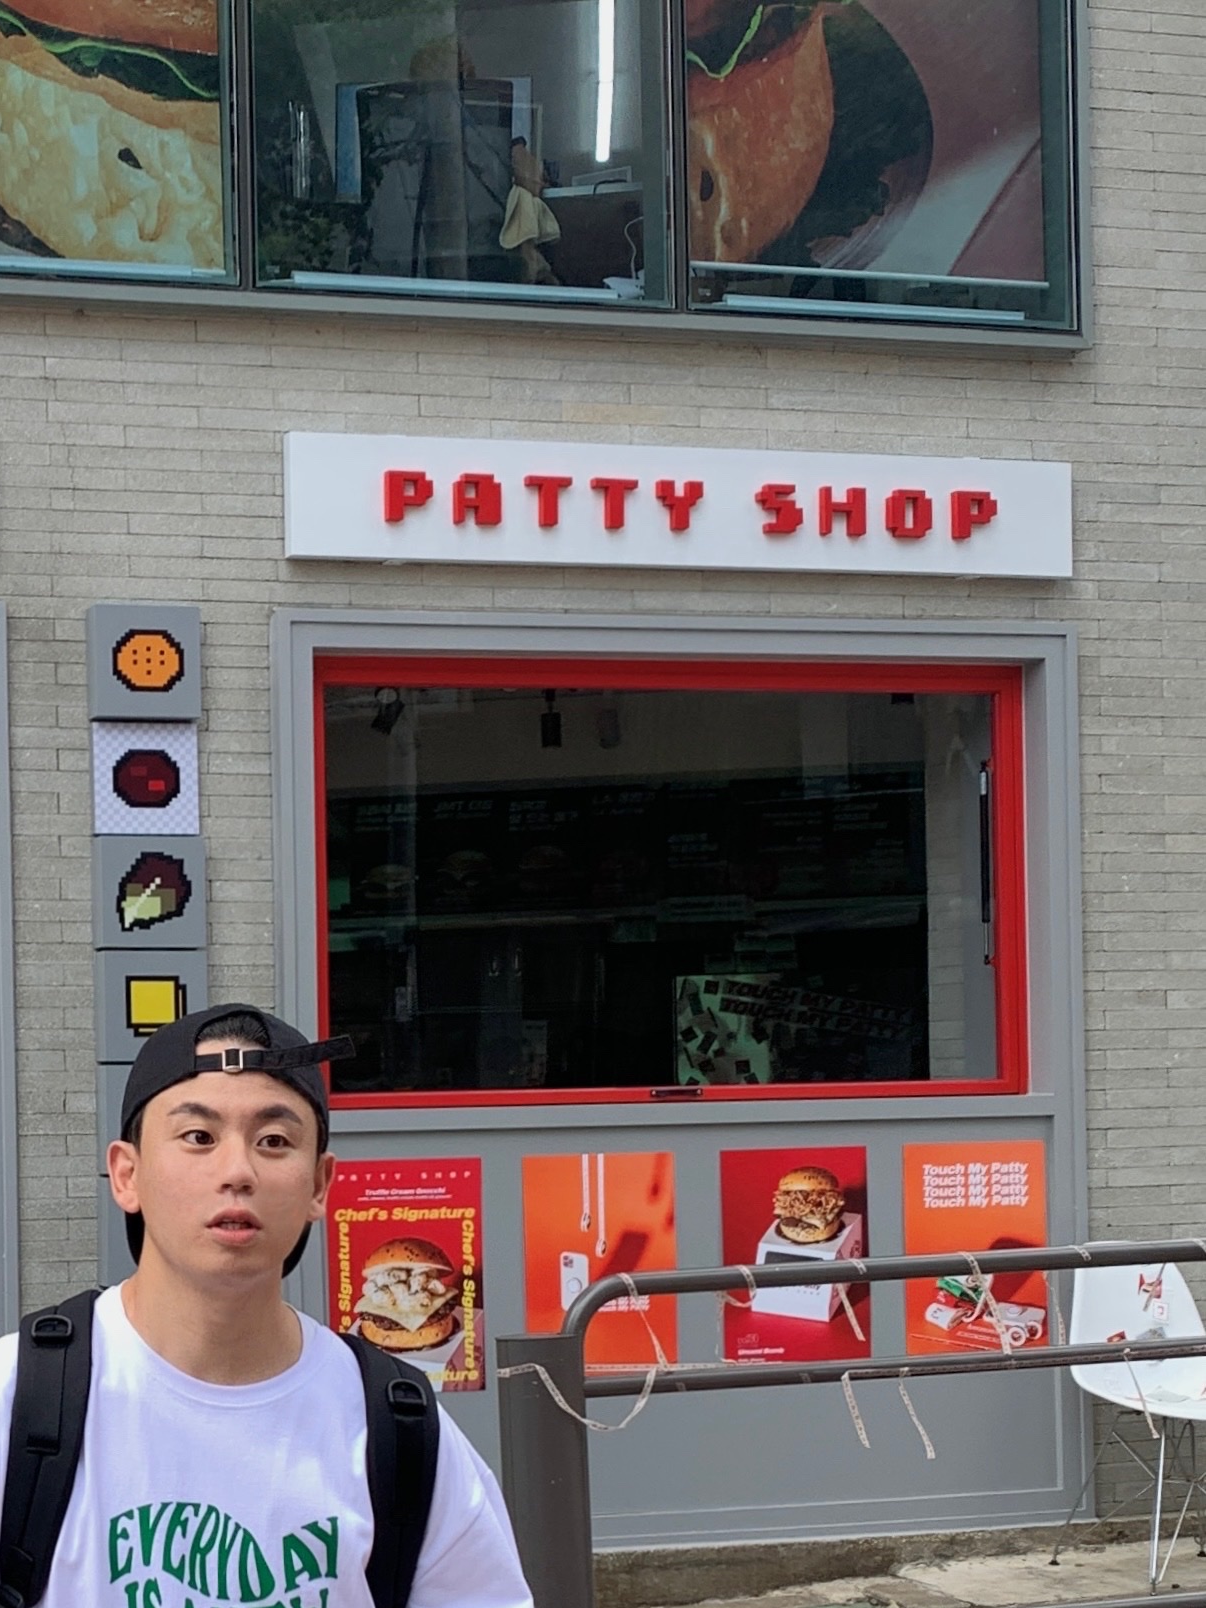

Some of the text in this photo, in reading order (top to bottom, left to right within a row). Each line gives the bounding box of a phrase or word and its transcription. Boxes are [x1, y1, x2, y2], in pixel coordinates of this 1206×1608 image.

[384, 469, 998, 540] PATTY SHOP
[922, 1161, 1029, 1175] Touch My Patty
[922, 1173, 1029, 1186] Touch My Patty
[923, 1184, 1029, 1197] Touch My Patty
[923, 1195, 1029, 1208] Touch My Patty
[334, 1206, 476, 1222] Chef's Signature
[338, 1221, 353, 1312] Signature
[461, 1219, 476, 1369] Chef's Signature
[108, 1501, 339, 1603] EVERYDAY
